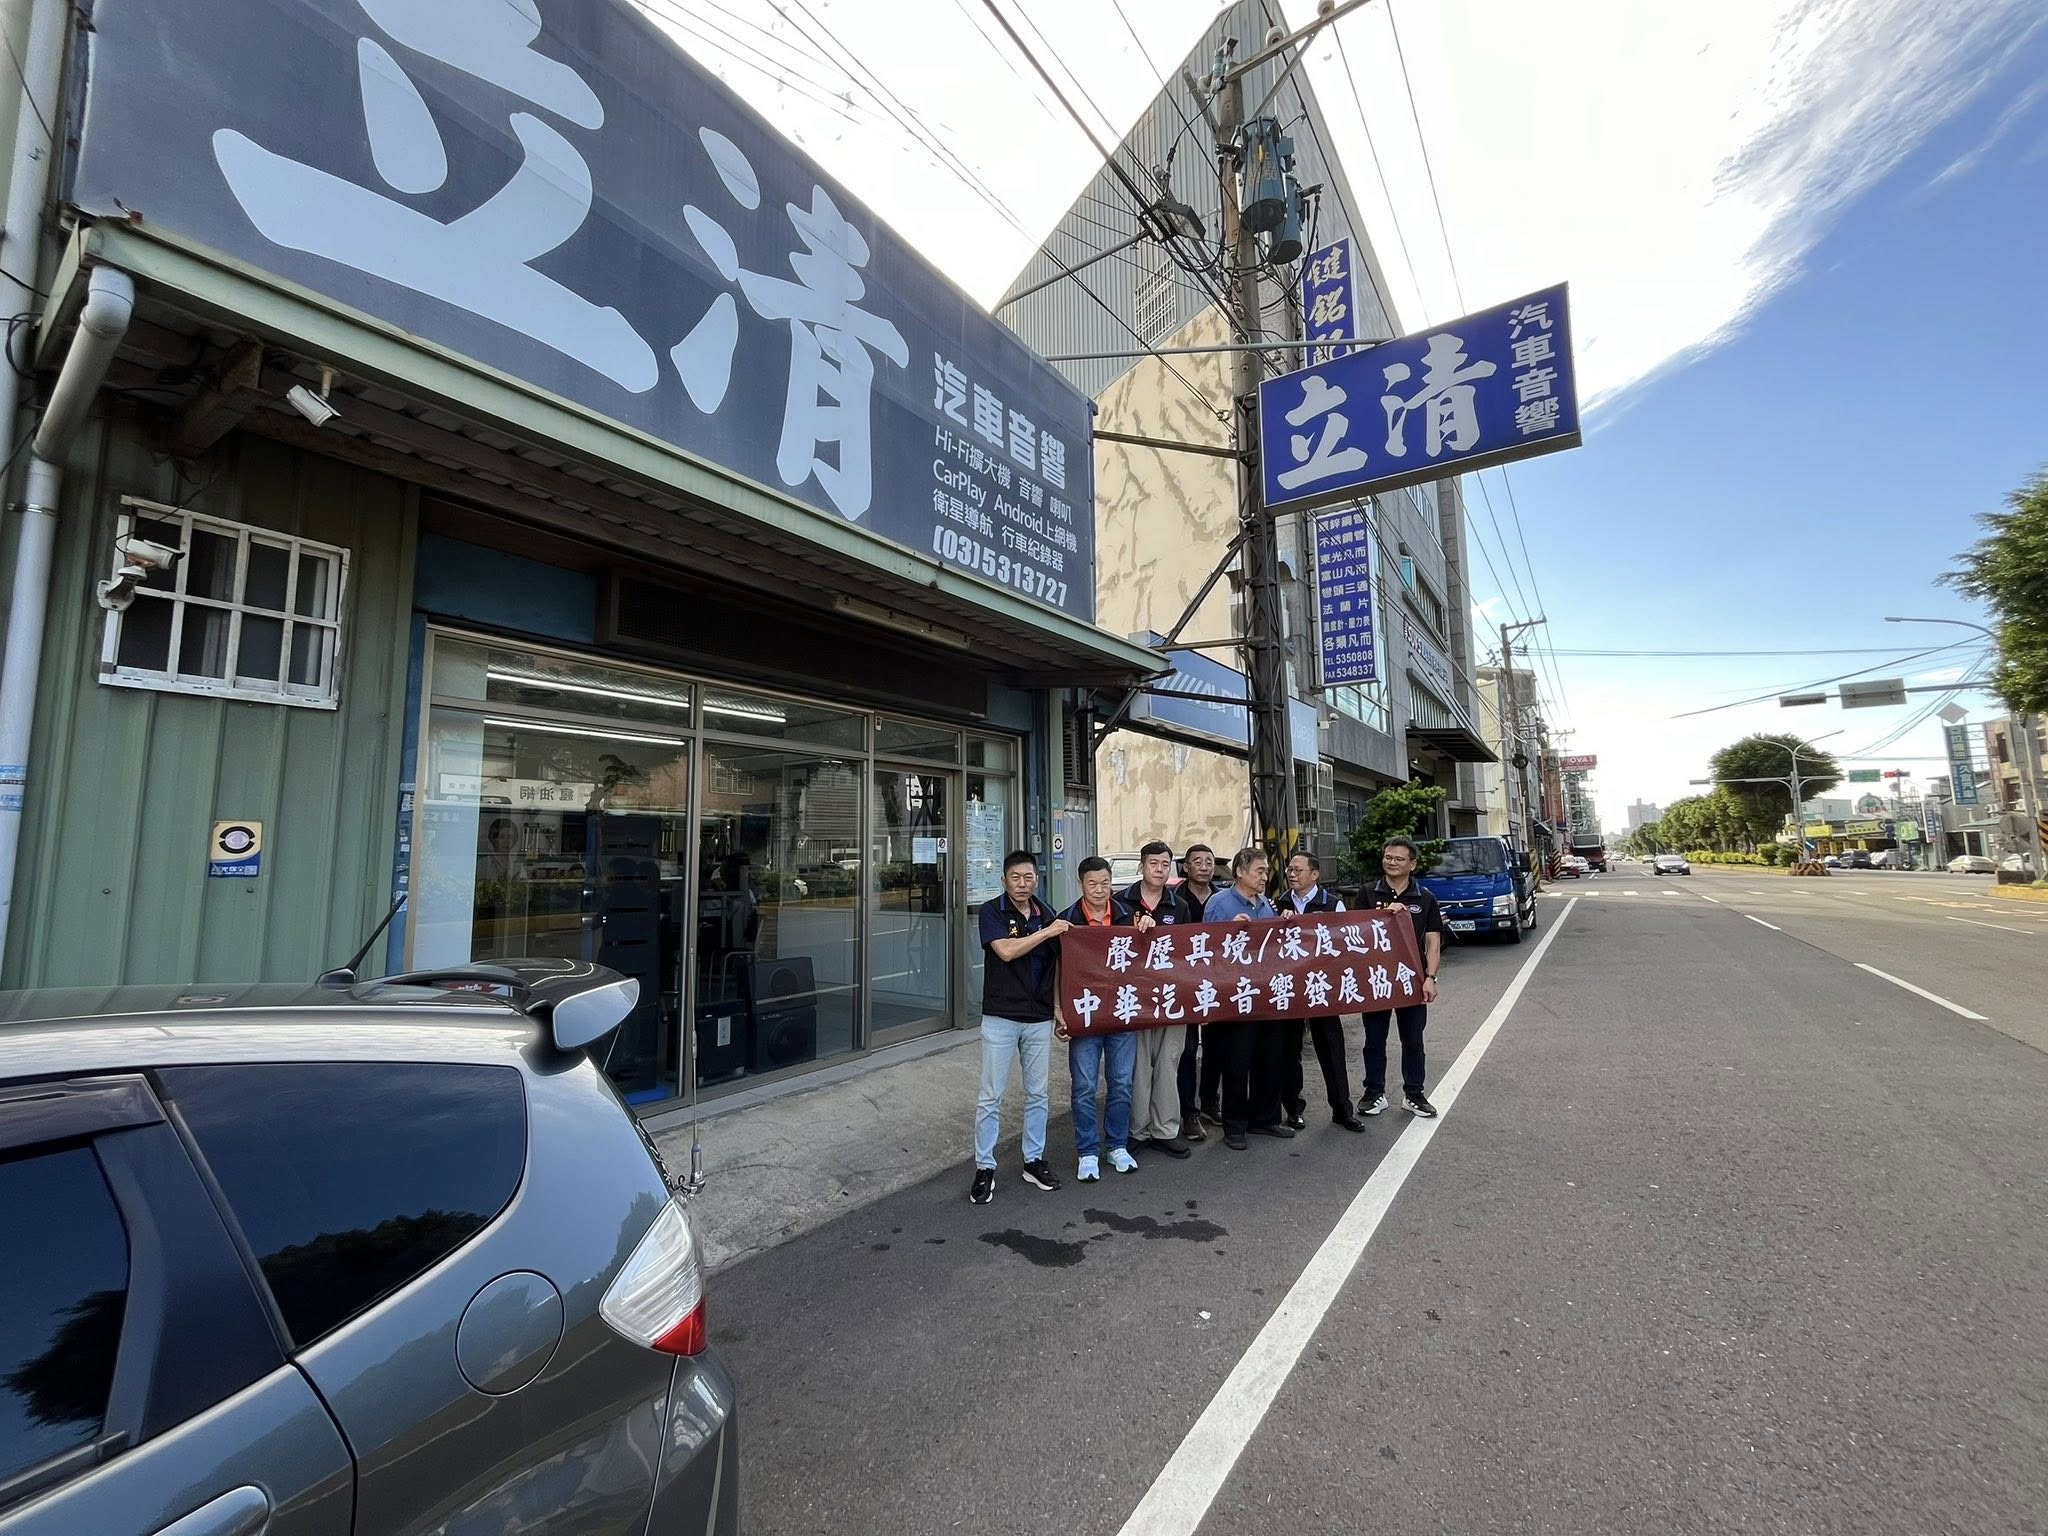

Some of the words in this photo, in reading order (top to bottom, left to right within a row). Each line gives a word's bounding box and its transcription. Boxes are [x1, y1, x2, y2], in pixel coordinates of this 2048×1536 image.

[211, 0, 909, 522] 立清
[1506, 301, 1561, 436] 汽車音響
[933, 351, 1066, 490] 汽車音響
[1276, 332, 1497, 491] 立清
[932, 458, 987, 508] CarPlay
[1018, 477, 1044, 508] 音響
[932, 488, 994, 539] 衛星導航
[1324, 657, 1335, 666] TEL
[1335, 650, 1373, 665] 5350808
[1325, 671, 1336, 679] FAX
[1336, 664, 1374, 678] 5348337
[1104, 918, 1393, 973] 聲歷其境/深度巡店
[1072, 961, 1417, 1028] 中華汽車音響發展協會
